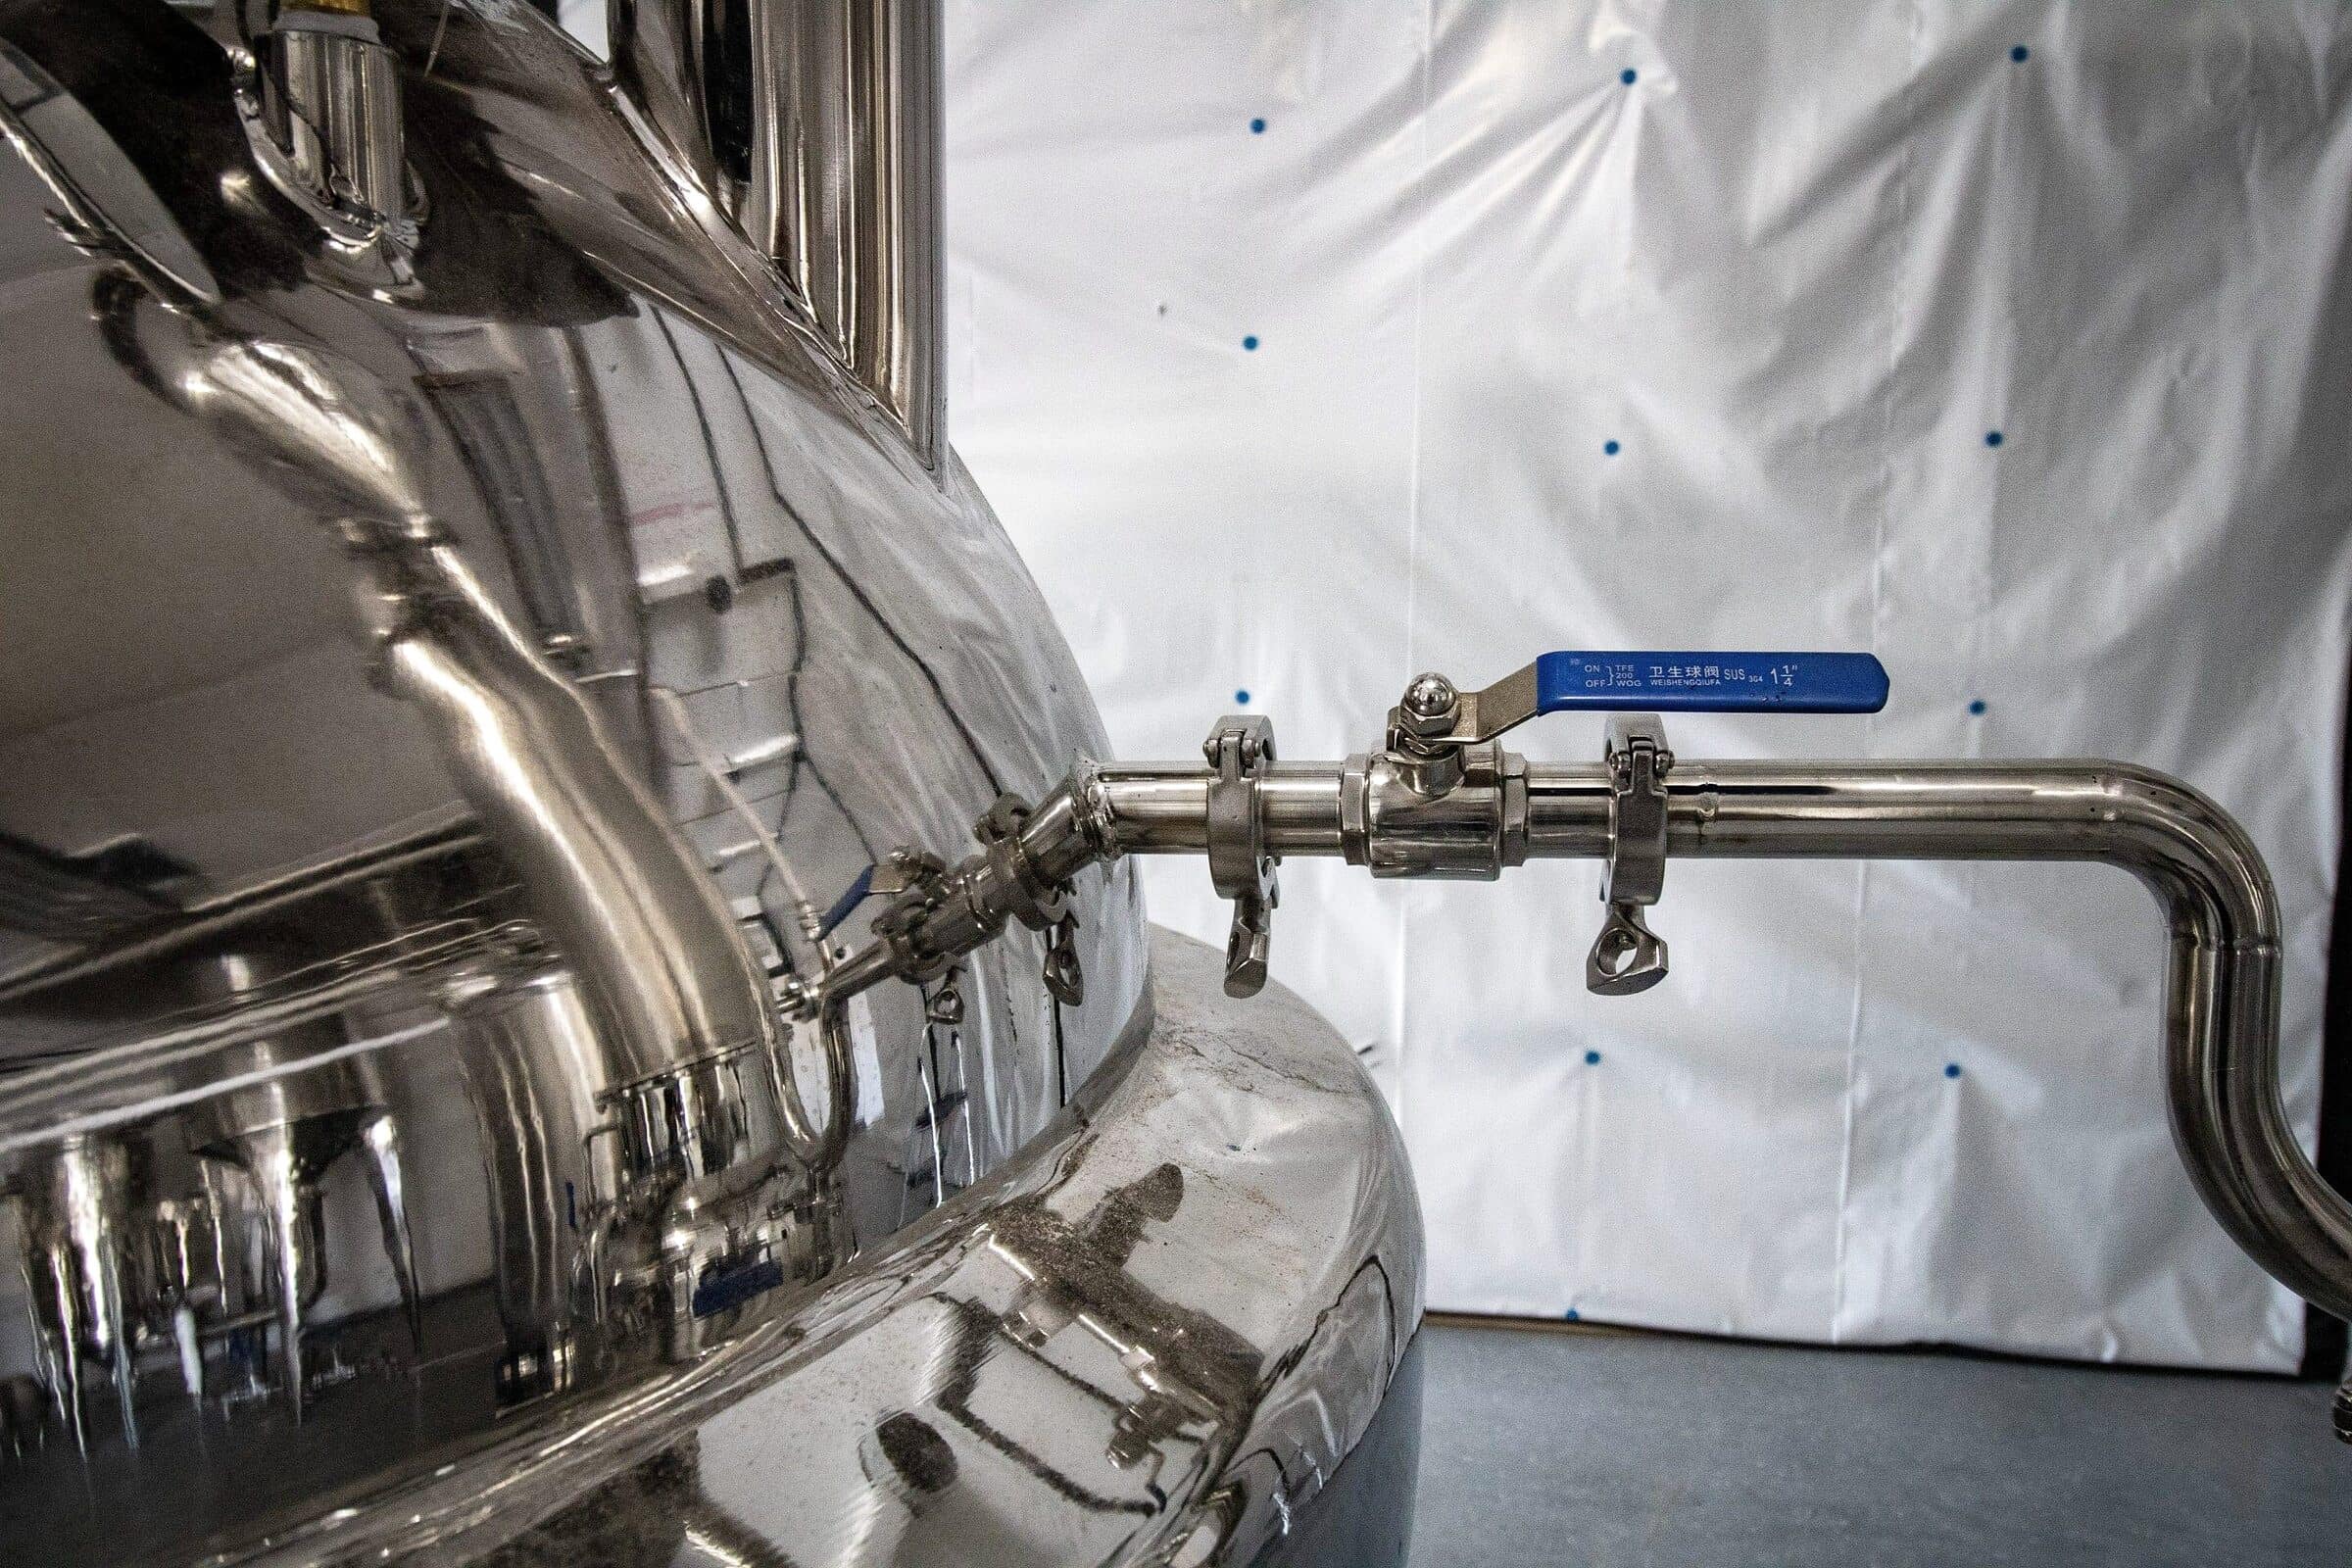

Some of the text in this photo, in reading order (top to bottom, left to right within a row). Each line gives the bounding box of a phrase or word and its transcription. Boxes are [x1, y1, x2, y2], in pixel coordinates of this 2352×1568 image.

[1584, 664, 1600, 673] ON
[1648, 664, 1720, 678] 卫生球阀
[1724, 668, 1745, 680] SUS
[1585, 679, 1606, 688] OFF
